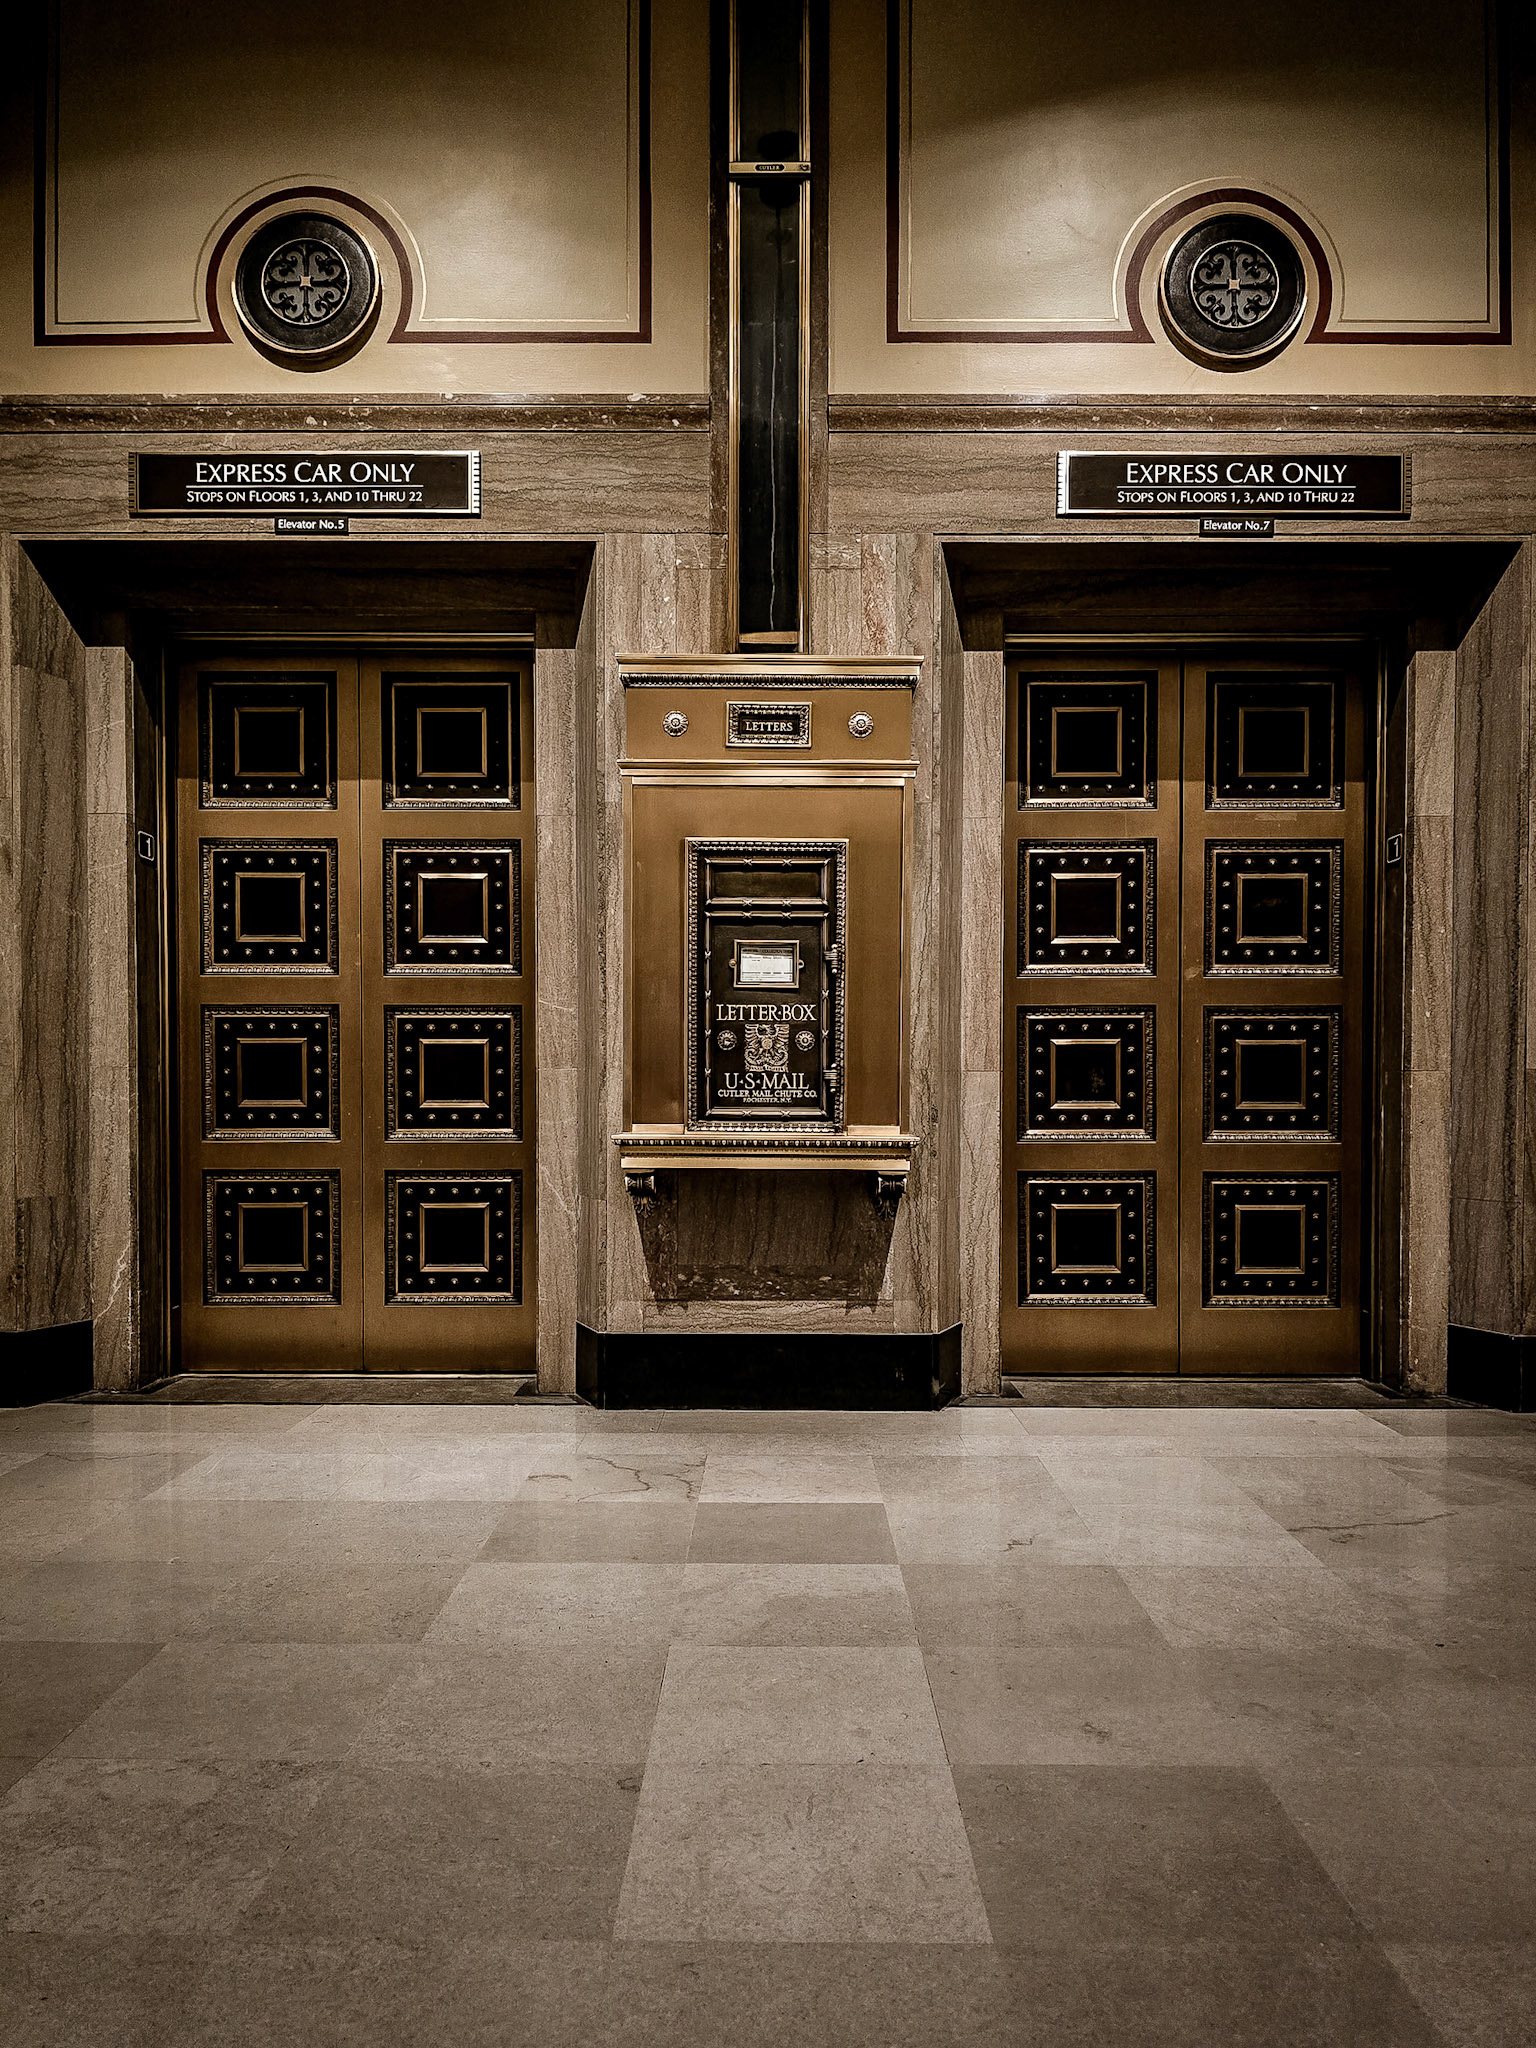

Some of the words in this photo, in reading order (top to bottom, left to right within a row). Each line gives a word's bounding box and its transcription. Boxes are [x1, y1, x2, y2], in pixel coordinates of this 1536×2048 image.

[195, 462, 287, 484] EXPRESS
[294, 461, 343, 484] CAR
[350, 461, 416, 484] ONLY
[1126, 462, 1219, 485] EXPRESS
[1226, 462, 1275, 485] CAR
[1282, 462, 1348, 485] ONLY
[186, 490, 224, 503] STOPS
[226, 491, 246, 503] ON
[249, 490, 296, 503] FLOORS
[299, 491, 309, 505] 1,
[312, 491, 322, 505] 3,
[325, 491, 352, 503] AND
[355, 491, 369, 503] 10
[371, 489, 405, 503] THRU
[408, 491, 423, 503] 22
[1117, 491, 1154, 504] STOPS
[1156, 492, 1177, 504] ON
[1180, 491, 1228, 504] FLOORS
[1231, 491, 1241, 506] 1,
[1243, 492, 1255, 506] 3,
[1256, 492, 1285, 504] AND
[1287, 492, 1301, 504] 10
[1303, 491, 1337, 504] THRU
[1340, 492, 1355, 504] 22
[277, 518, 317, 530] Elevator
[1203, 519, 1243, 531] Elevator
[745, 721, 794, 732] LETTERS
[717, 1089, 750, 1098] CUTLER
[751, 1090, 773, 1098] MAIL
[774, 1089, 802, 1098] CHUTE
[803, 1089, 818, 1098] CO.
